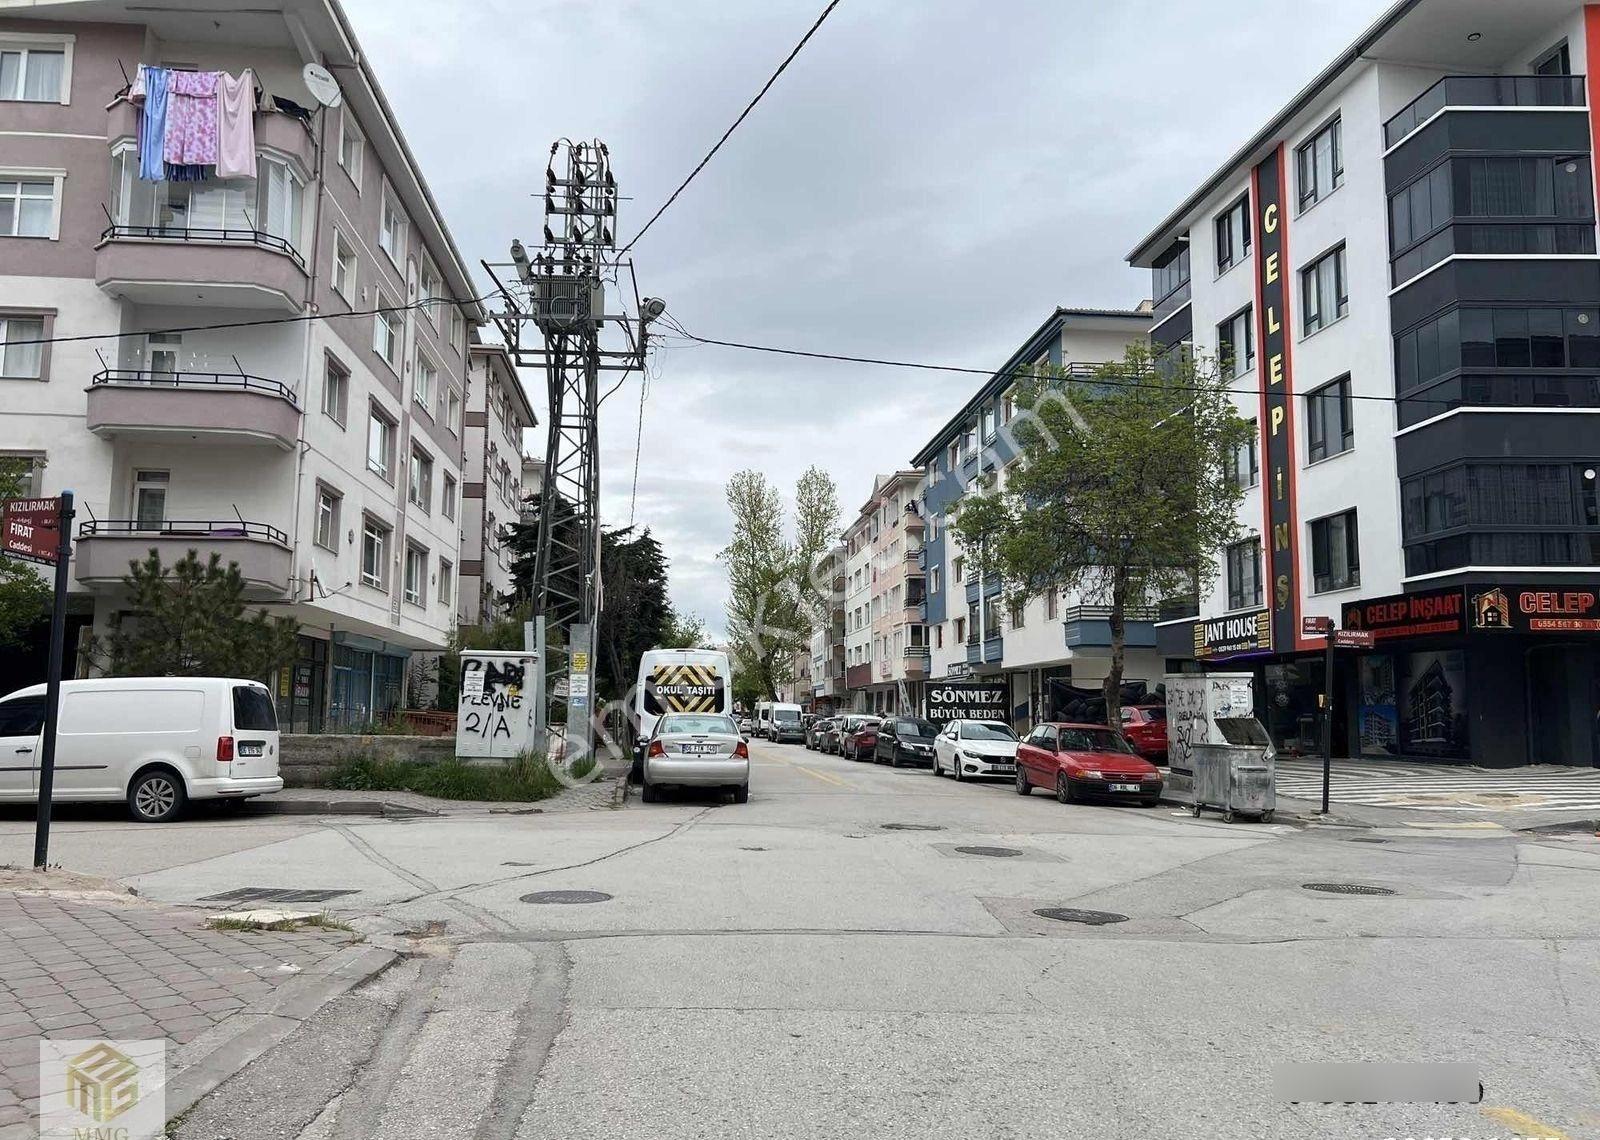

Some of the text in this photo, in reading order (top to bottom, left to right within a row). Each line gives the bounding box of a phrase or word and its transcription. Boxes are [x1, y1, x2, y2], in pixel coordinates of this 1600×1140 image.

[1264, 203, 1284, 436] CELEP
[10, 501, 55, 512] KIZILIRMAK
[10, 523, 34, 538] FIRAT
[9, 540, 33, 553] Caddesi
[1367, 594, 1462, 624] CELEP İNŞAAT
[1519, 592, 1595, 613] CELEP
[1204, 621, 1224, 646] JANT
[1226, 615, 1258, 640] HOUSE
[656, 685, 715, 696] OKUL TAŞITI
[930, 686, 1003, 704] SÖNMEZ
[930, 706, 1005, 720] BÜYÜK BEDEN
[464, 711, 512, 738] 2/A
